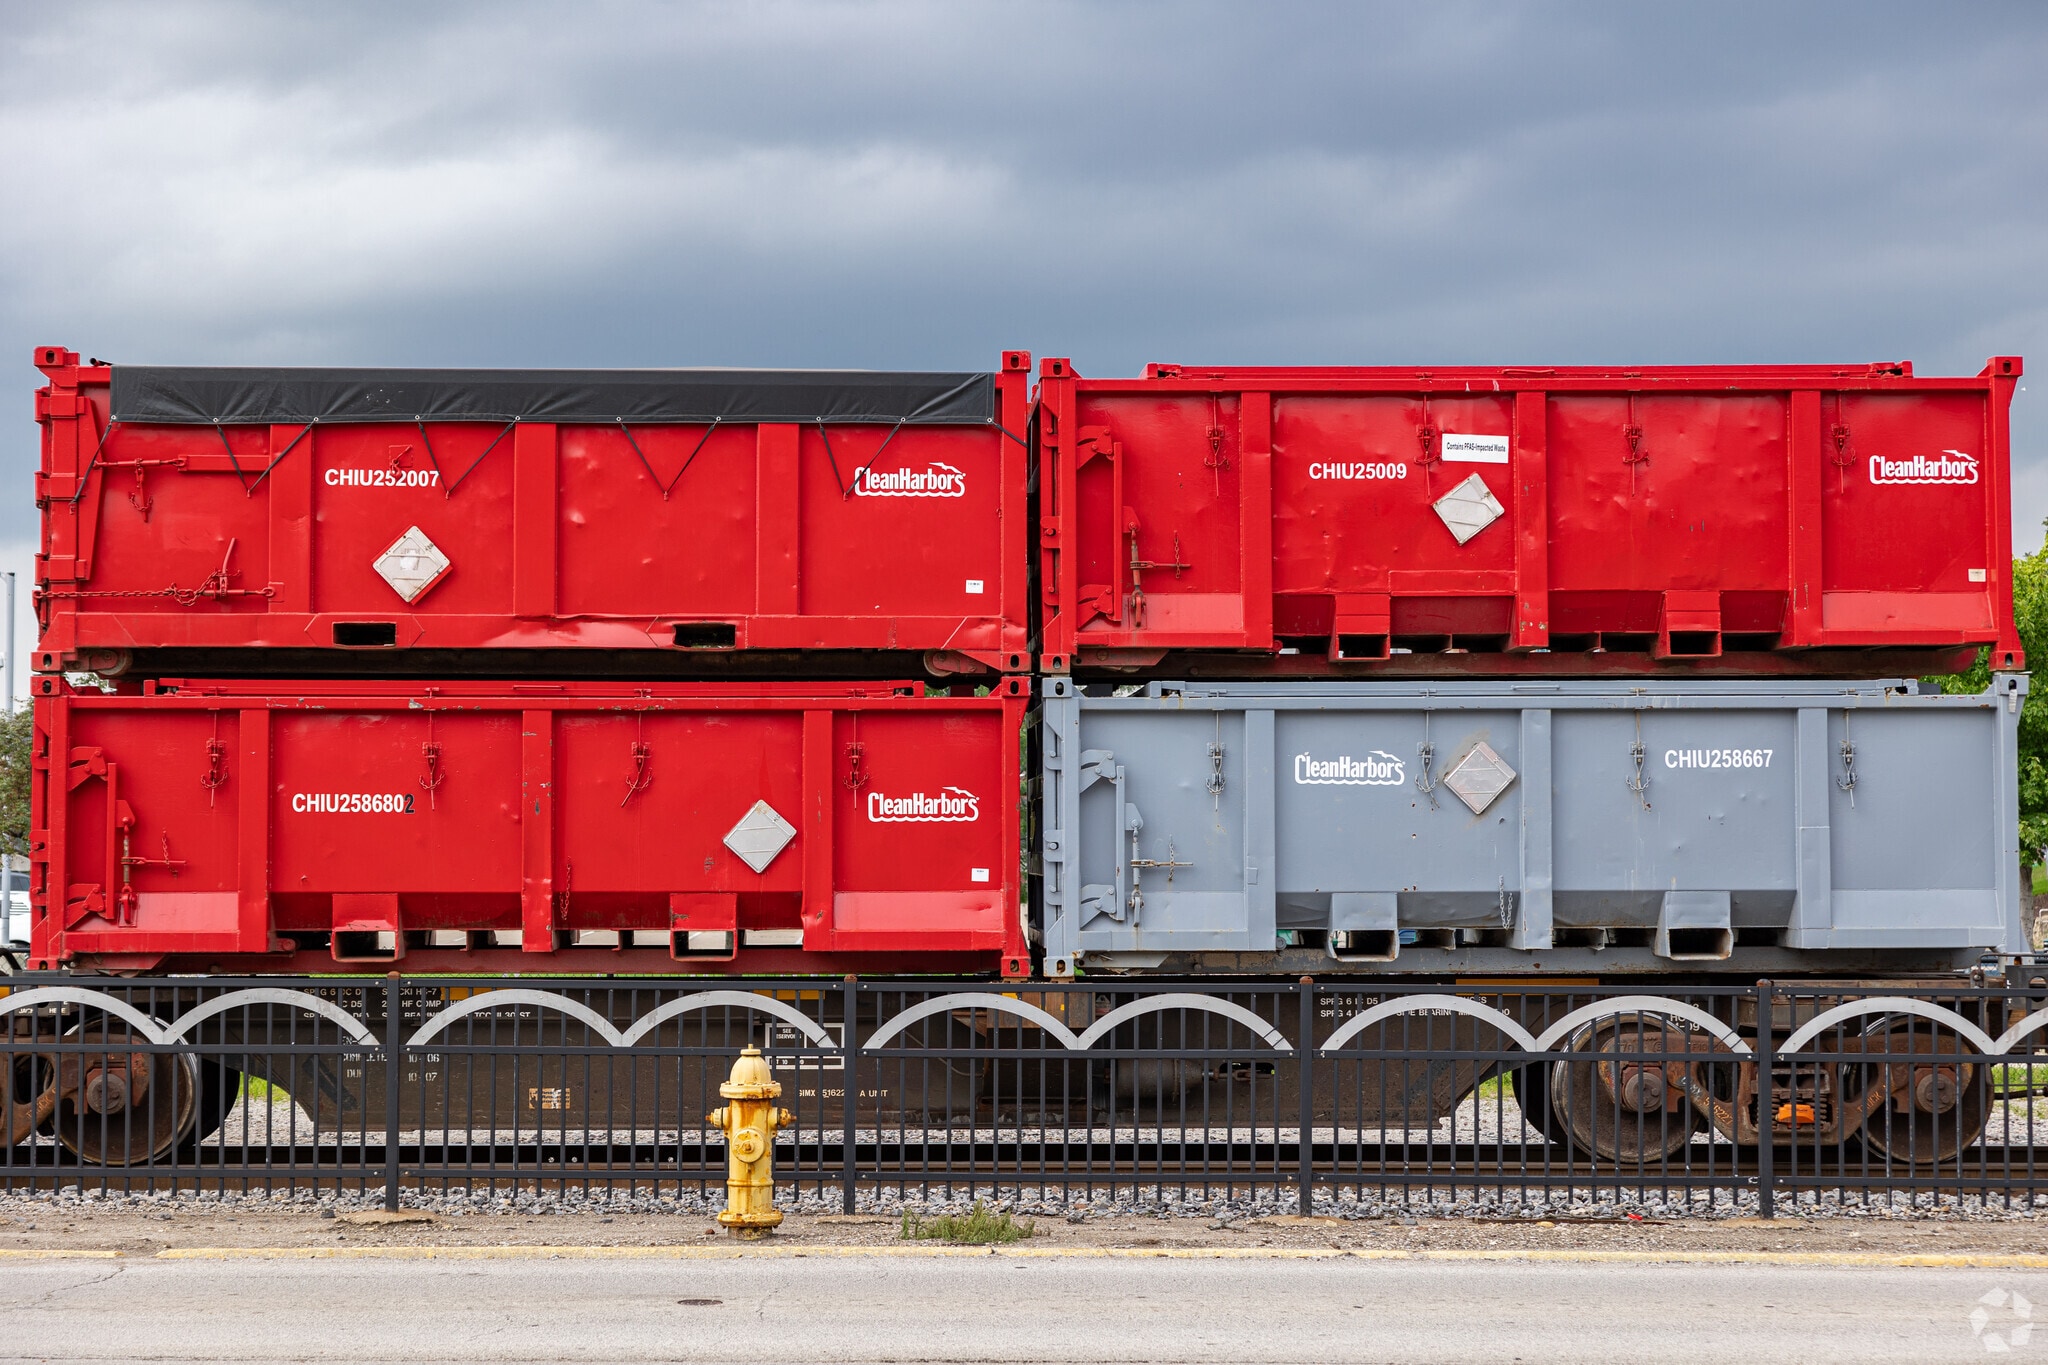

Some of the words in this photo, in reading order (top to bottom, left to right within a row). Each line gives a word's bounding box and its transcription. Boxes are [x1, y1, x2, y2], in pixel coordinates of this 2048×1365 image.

[1446, 441, 1464, 451] Contains
[1464, 442, 1494, 453] PFAS-Impacted
[1494, 444, 1506, 453] Waste
[324, 468, 439, 487] CHIU252007
[1308, 462, 1407, 480] CHIU25009
[1868, 455, 1979, 485] CleanHarbors
[854, 466, 966, 497] CleanHarbors
[1664, 748, 1774, 769] CHIU258667
[1294, 754, 1405, 786] CleanHarbors
[867, 792, 980, 822] CleanHarbors
[303, 987, 327, 996] SPG
